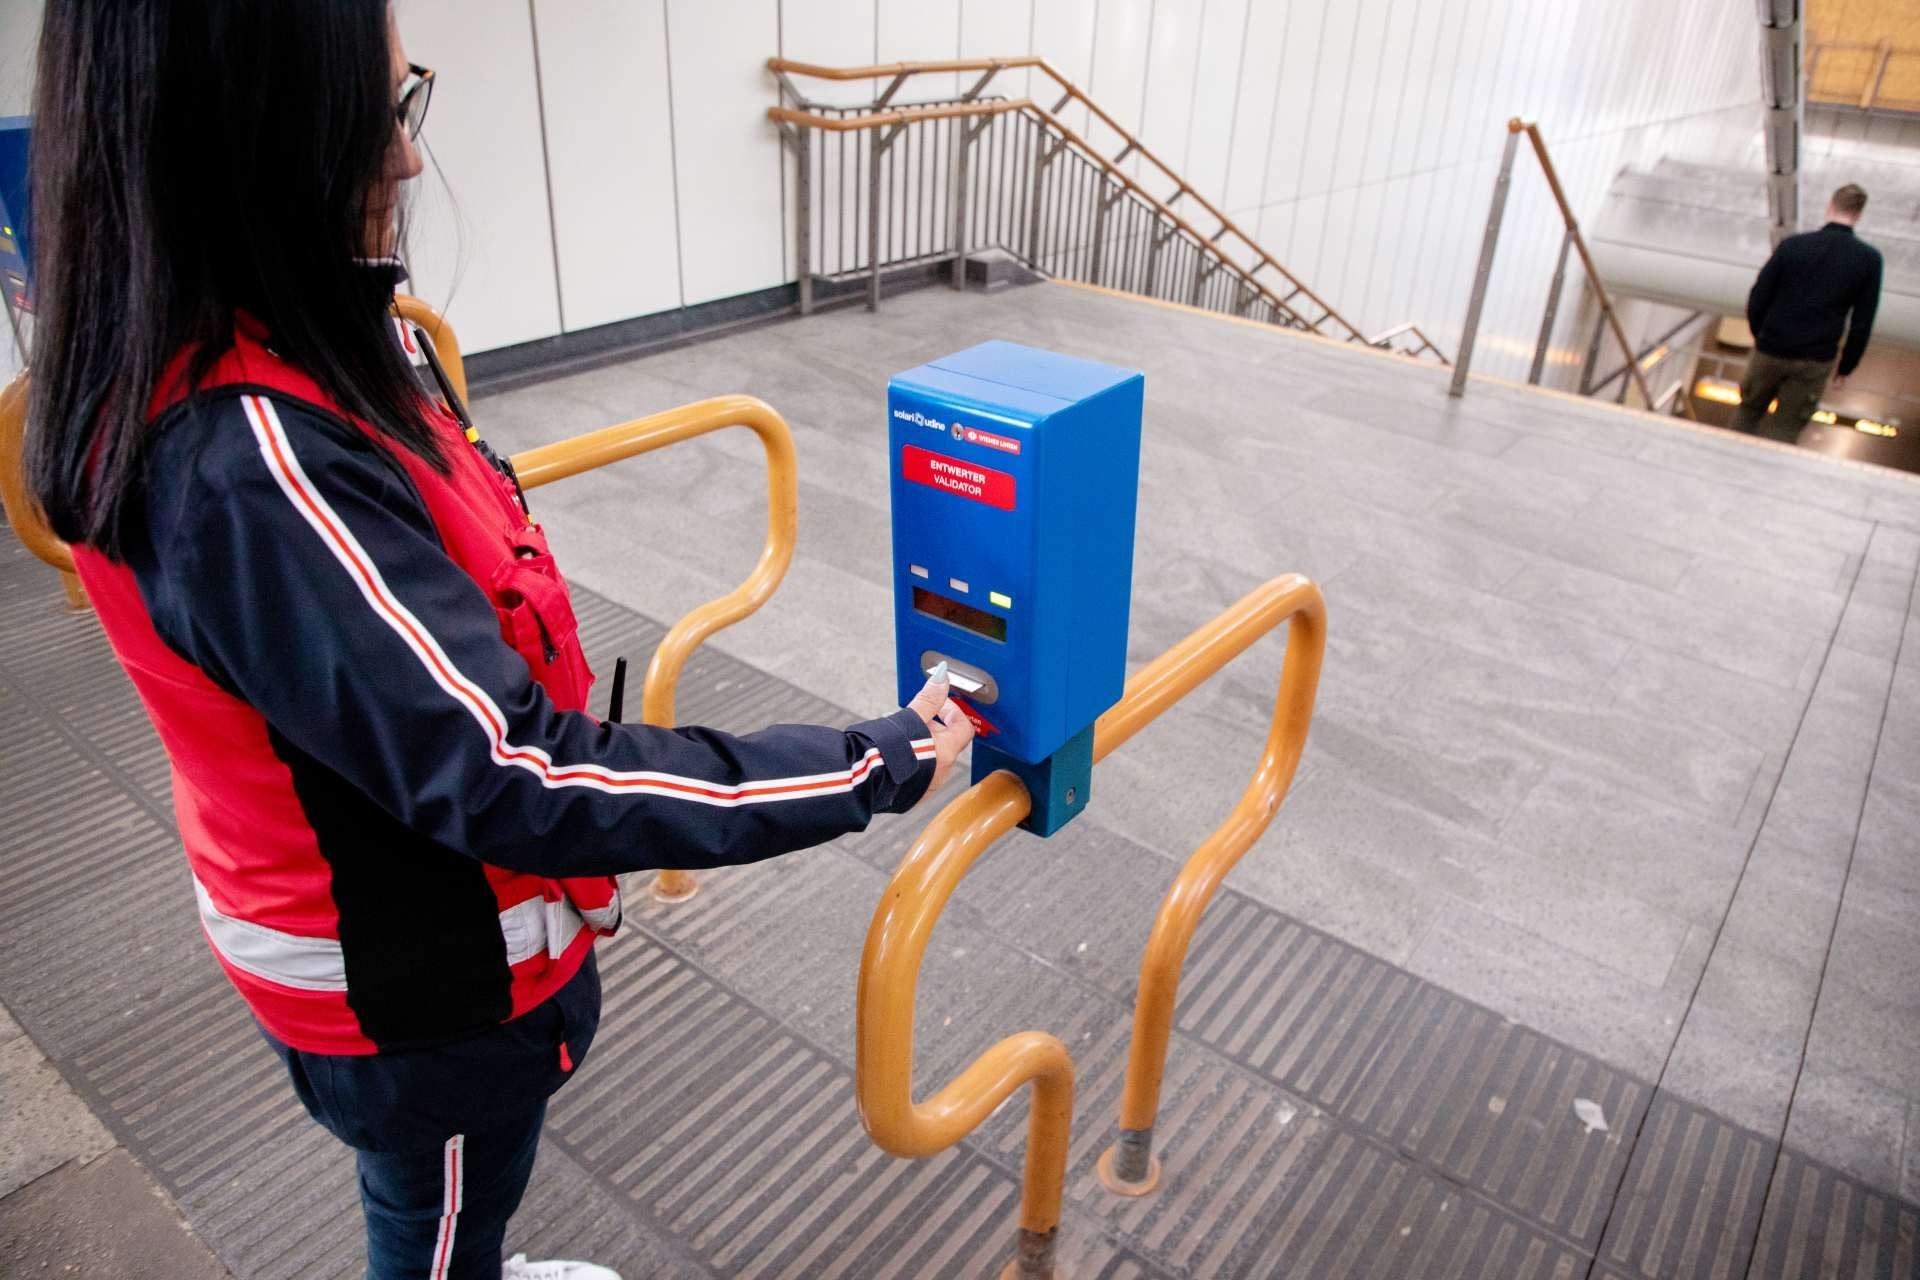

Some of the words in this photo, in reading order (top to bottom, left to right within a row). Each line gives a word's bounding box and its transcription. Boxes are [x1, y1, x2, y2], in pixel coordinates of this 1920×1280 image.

[894, 409, 914, 422] solari
[925, 419, 945, 431] udine
[930, 460, 986, 484] ENTWERTER
[934, 474, 982, 496] VALIDATOR
